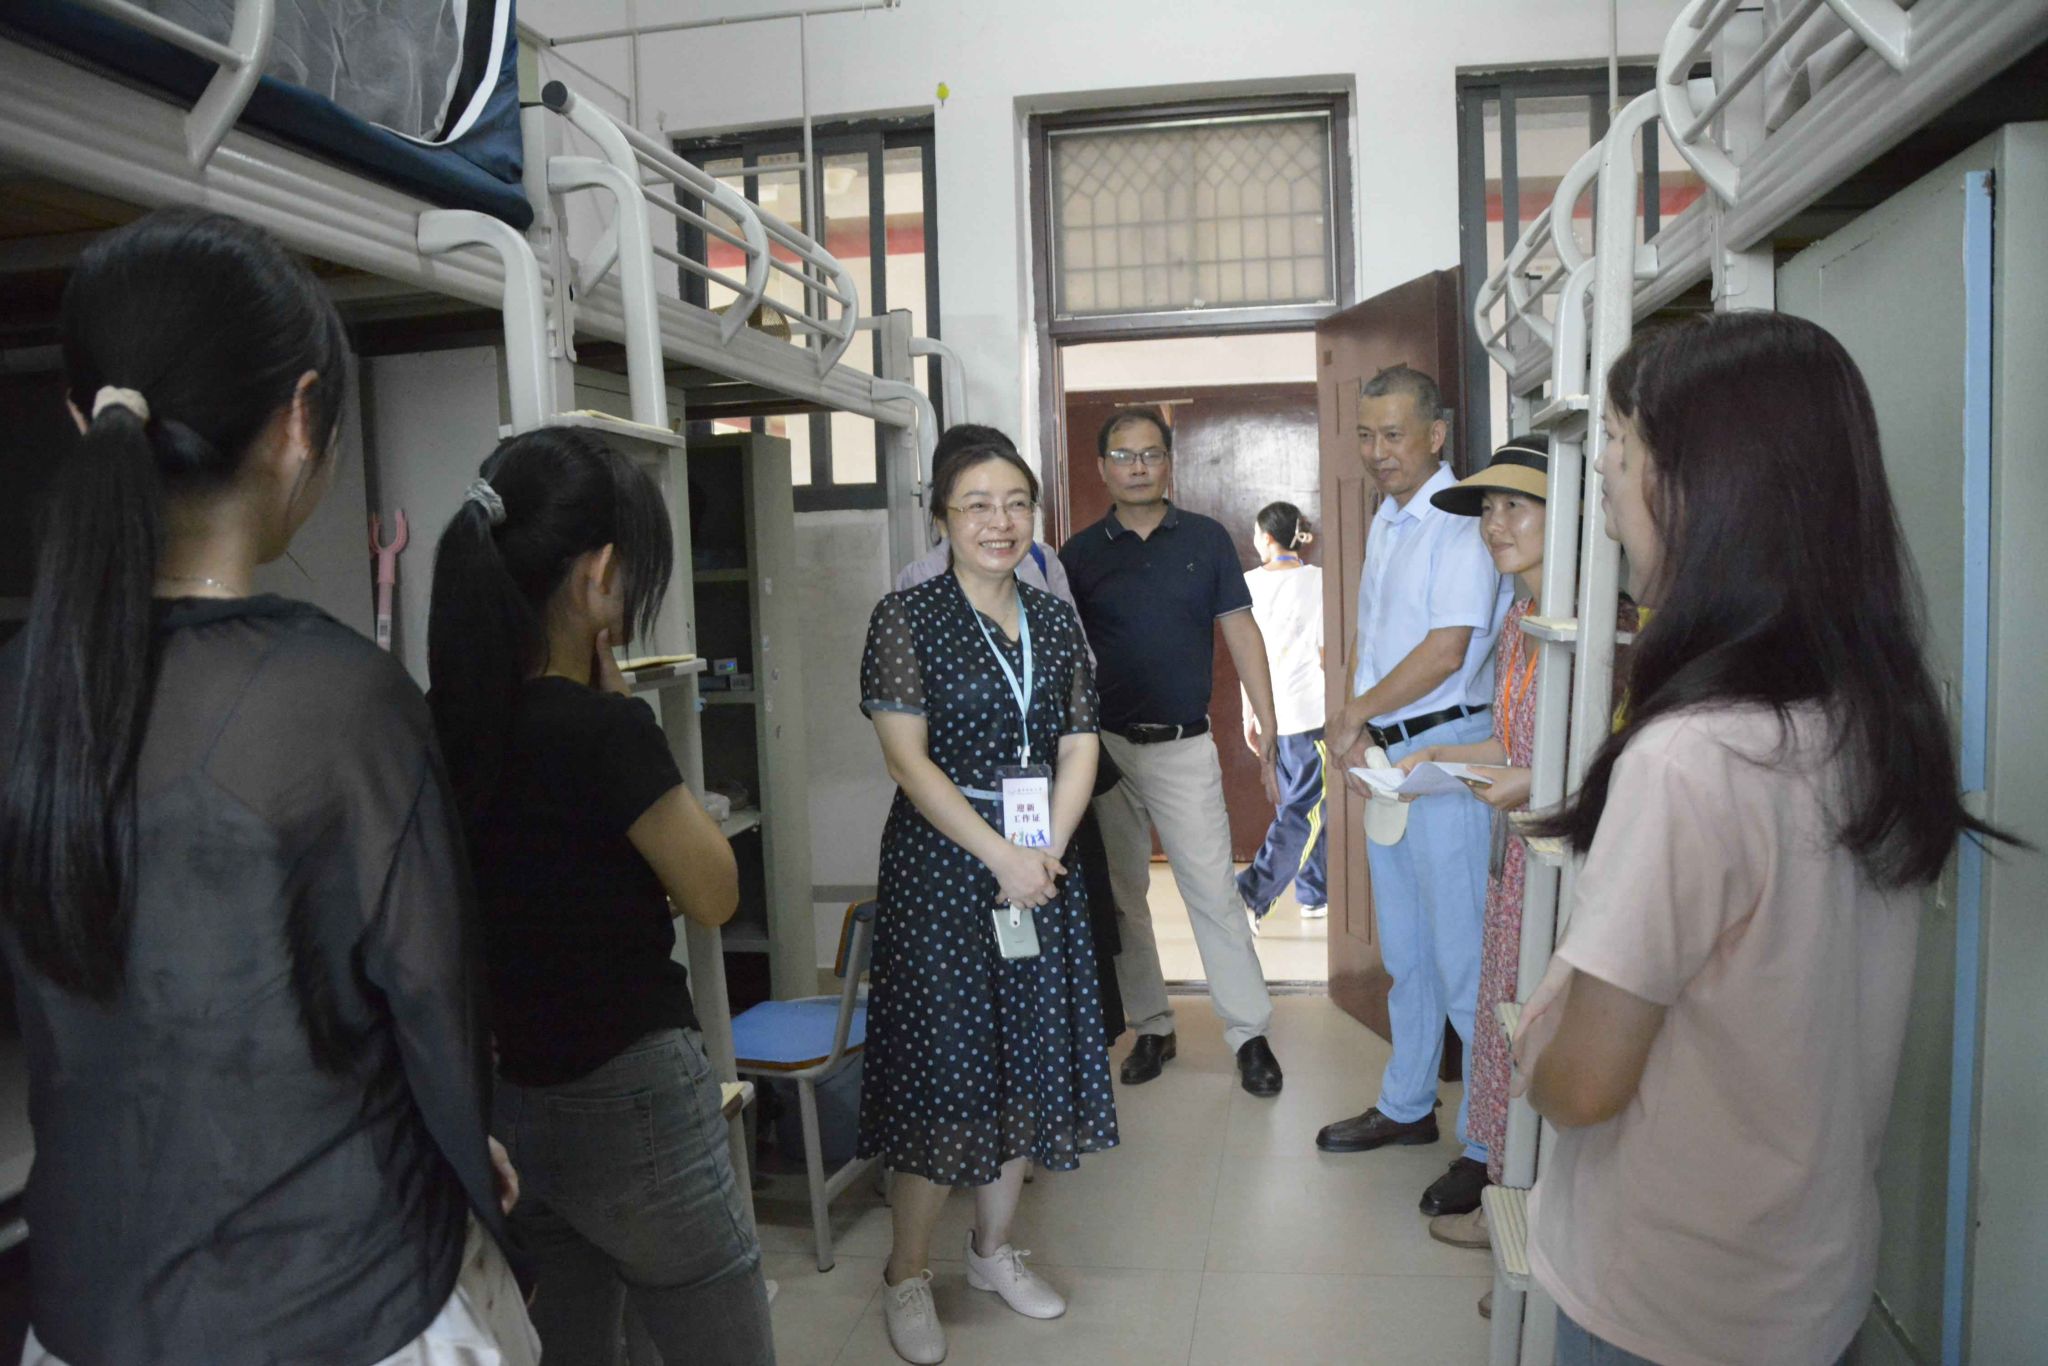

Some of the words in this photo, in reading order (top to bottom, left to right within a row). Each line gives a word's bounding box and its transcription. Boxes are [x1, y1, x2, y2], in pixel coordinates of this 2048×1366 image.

[1016, 803, 1035, 812] 迎新
[1015, 813, 1041, 823] 工作证
